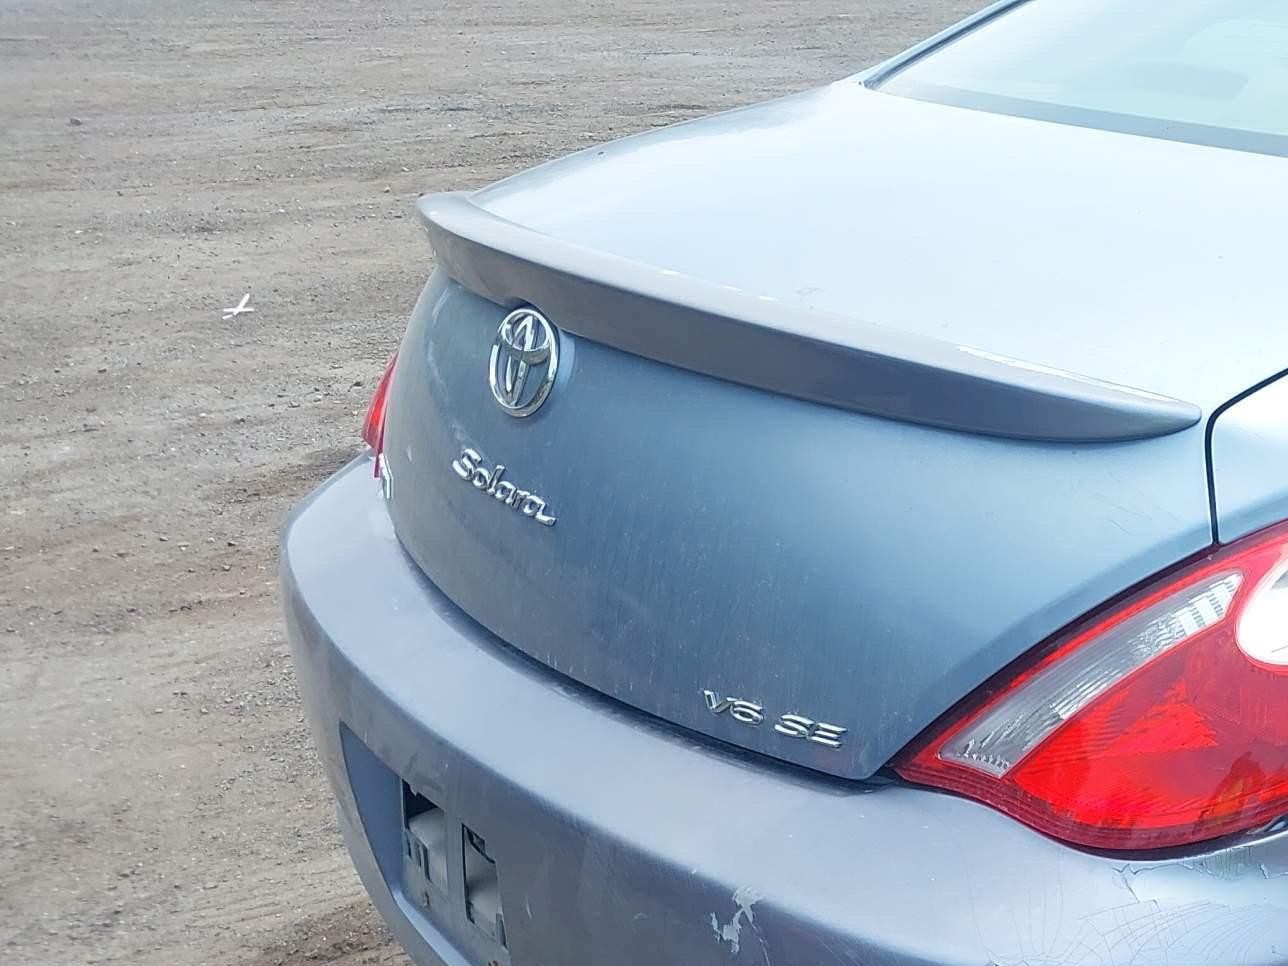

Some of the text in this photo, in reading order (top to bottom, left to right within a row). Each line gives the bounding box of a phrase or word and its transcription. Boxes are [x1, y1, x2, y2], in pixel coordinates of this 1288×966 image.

[452, 448, 557, 526] Solara
[703, 690, 848, 748] V6 SE
